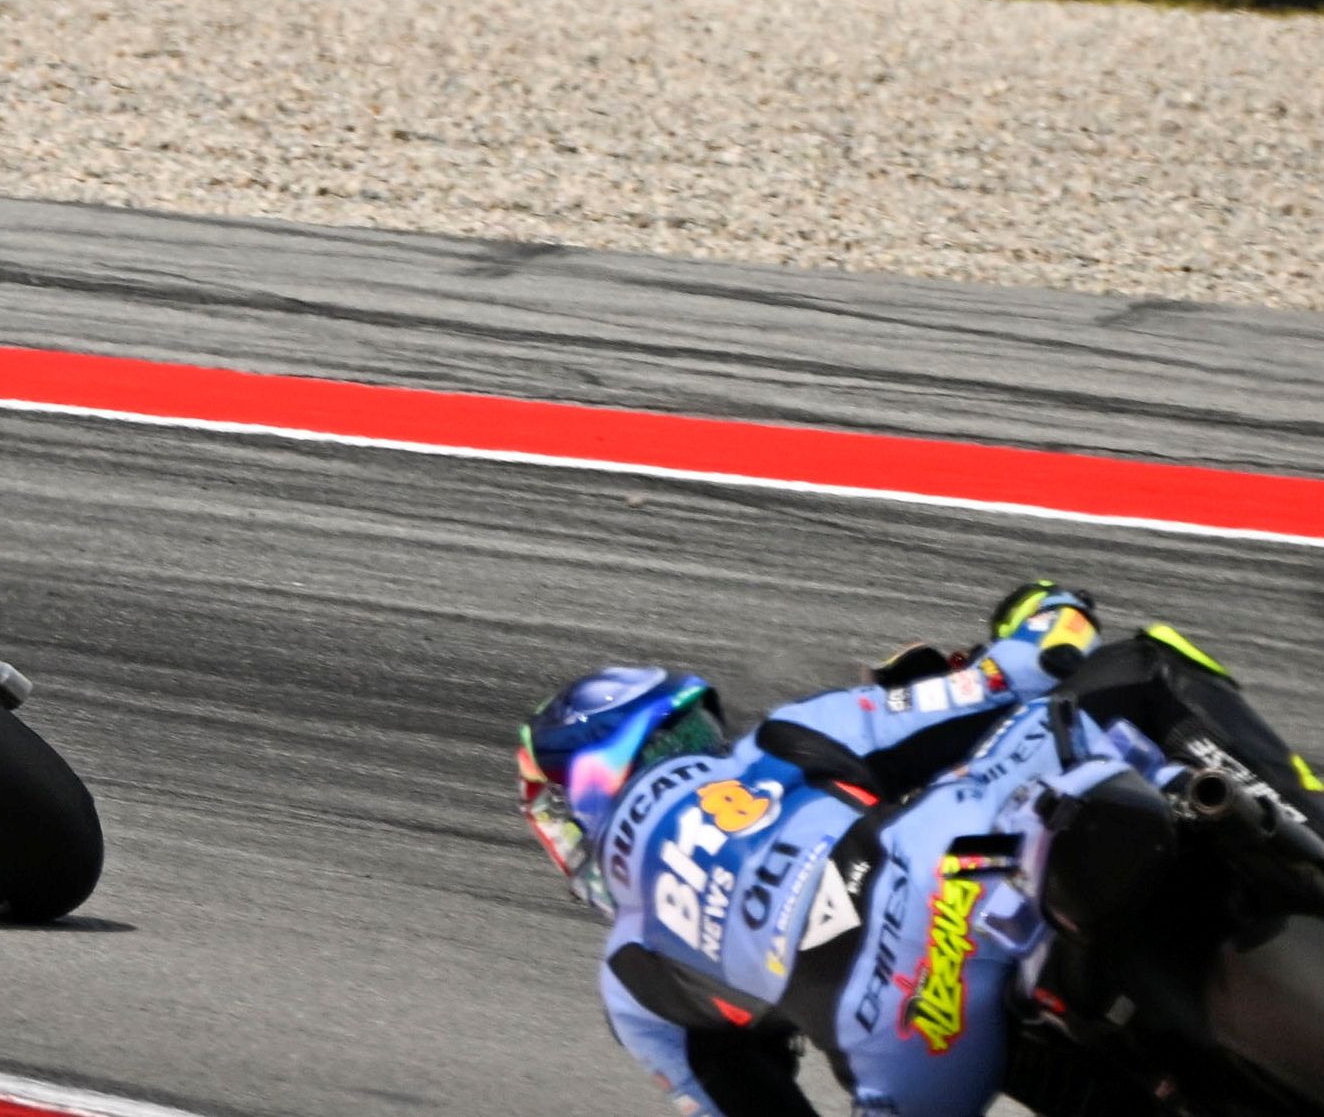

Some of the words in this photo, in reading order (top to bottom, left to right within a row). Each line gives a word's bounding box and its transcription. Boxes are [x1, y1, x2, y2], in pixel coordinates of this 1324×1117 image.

[609, 761, 711, 891] DUCATI
[701, 865, 736, 963] NEWS
[912, 853, 984, 1055] ALDEGUE
